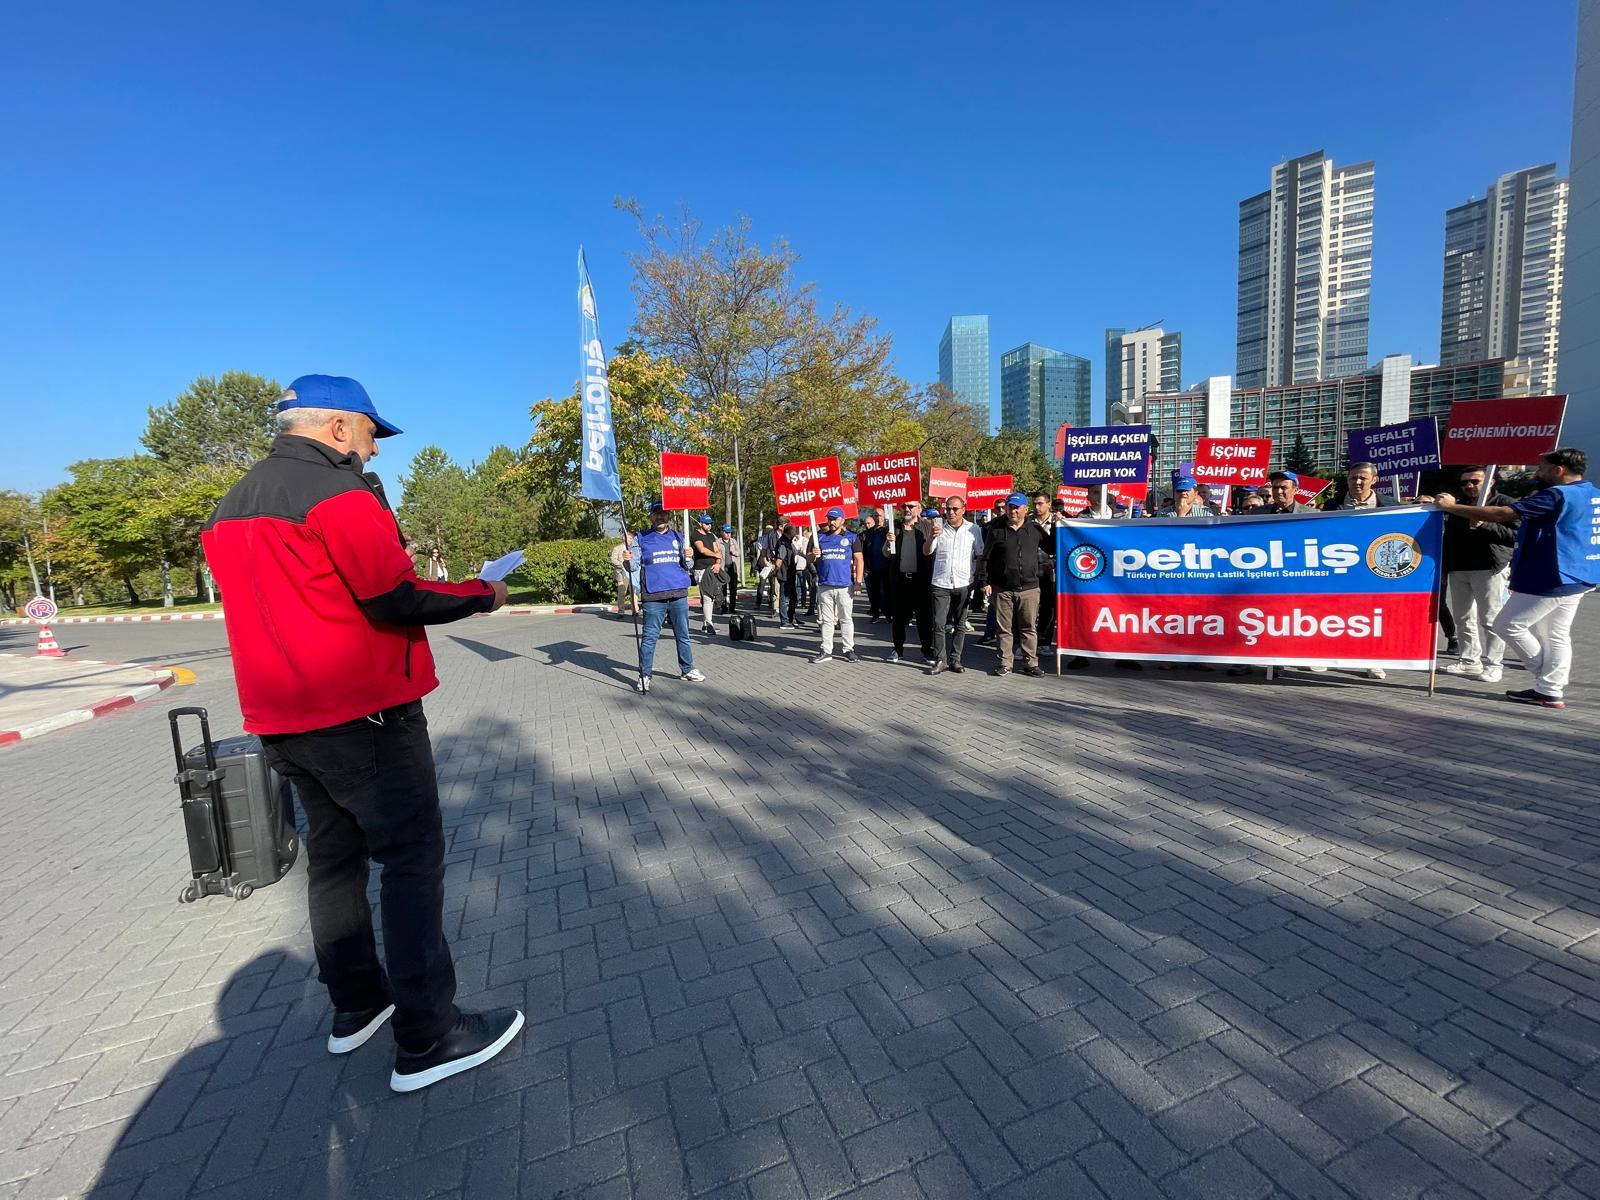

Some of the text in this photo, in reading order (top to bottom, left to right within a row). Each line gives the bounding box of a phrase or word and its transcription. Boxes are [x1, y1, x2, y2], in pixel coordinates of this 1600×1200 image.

[1067, 433, 1149, 448] İŞÇİLER AÇKEN
[1364, 427, 1417, 445] SEFALET
[1449, 423, 1557, 441] GEÇİNEMİYORUZ
[1071, 451, 1142, 462] PATRONLARA
[1210, 443, 1257, 460] İŞÇİNE
[1369, 440, 1415, 458] ÜCRETİ
[860, 460, 881, 473] ADİL
[1376, 454, 1438, 471] MİYORUZ
[786, 466, 828, 485] İŞÇİNE
[867, 472, 911, 486] İNSANCA
[1074, 467, 1137, 479] HUZUR YOK
[1196, 463, 1237, 477] SAHİP
[1240, 467, 1265, 481] ÇIK
[663, 475, 707, 489] GEÇİNEMİYORUZ
[778, 488, 816, 506] SAHİP
[819, 486, 842, 502] ÇIK
[872, 488, 907, 501] YAŞAM
[967, 487, 1012, 498] GEÇİNEMİYORUZ
[1113, 539, 1360, 577] petrol-iş
[1126, 569, 1330, 580] Türkiye Petrol Kimya Lastik İşçileri Sendikası
[1092, 607, 1383, 646] Ankara Şubesi
